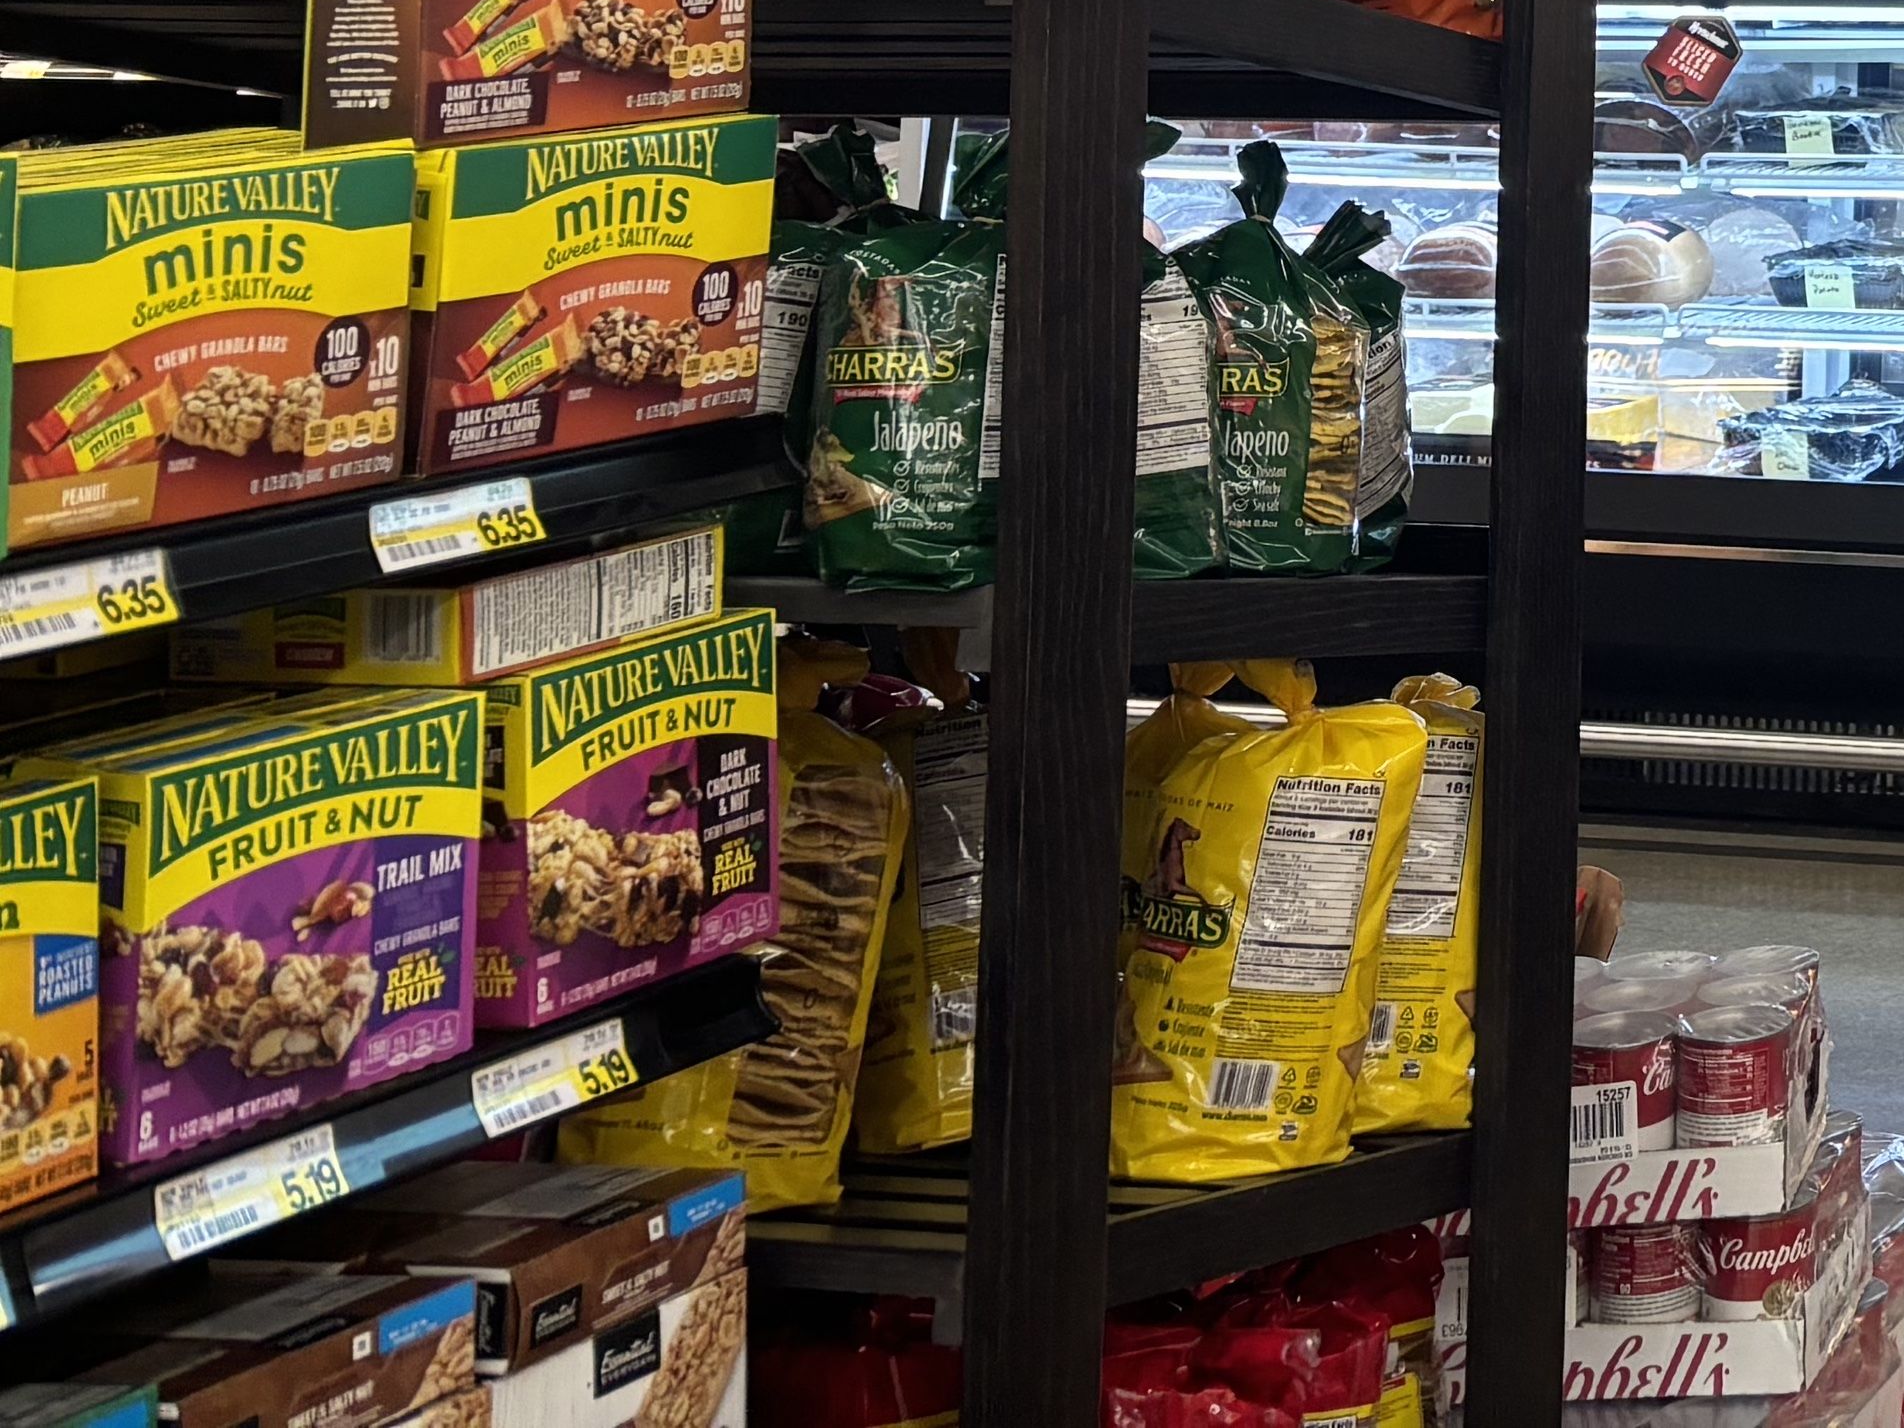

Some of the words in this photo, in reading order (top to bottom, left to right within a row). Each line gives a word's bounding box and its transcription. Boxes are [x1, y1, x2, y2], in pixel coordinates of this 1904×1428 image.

[526, 138, 631, 200] NATURE
[629, 128, 719, 178] VALLEY
[106, 182, 230, 250] NATURE
[232, 168, 340, 222] VALLEY
[555, 178, 690, 242] minis
[144, 224, 306, 296] minis
[544, 236, 600, 271] Sweet
[618, 226, 659, 248] SALTY
[659, 231, 693, 249] nut
[132, 292, 201, 328] Sweet
[222, 277, 270, 303] SALTY
[271, 282, 314, 303] nut
[702, 271, 729, 298] 100
[327, 326, 357, 358] 100
[870, 410, 963, 460] Jalapeño
[477, 504, 538, 547] 6.35
[97, 575, 166, 624] 6.35
[540, 662, 663, 753] NATURE
[661, 624, 765, 688] VALLEY
[581, 708, 660, 772] FRUIT
[666, 710, 679, 731] &
[683, 699, 736, 732] NUT
[706, 764, 761, 797] CHOCOLATE
[720, 748, 747, 772] DARK
[158, 748, 324, 864] NATURE
[324, 710, 468, 785] VALLEY
[1277, 778, 1341, 793] Nutrition
[1345, 780, 1381, 796] Facts
[1445, 781, 1472, 794] 181
[208, 812, 317, 882] FRUIT
[325, 808, 341, 835] &
[349, 795, 423, 834] NUT
[1266, 825, 1315, 839] Calories
[1348, 828, 1373, 841] 181
[377, 856, 425, 892] TRAIL
[429, 844, 463, 876] MIX
[712, 863, 756, 896] FRUIT
[714, 848, 754, 873] REAL
[382, 982, 445, 1015] FRUIT
[386, 961, 445, 991] REAL
[580, 1048, 631, 1097] 5.19
[1596, 1086, 1631, 1102] 15257
[281, 1158, 343, 1211] 5.19
